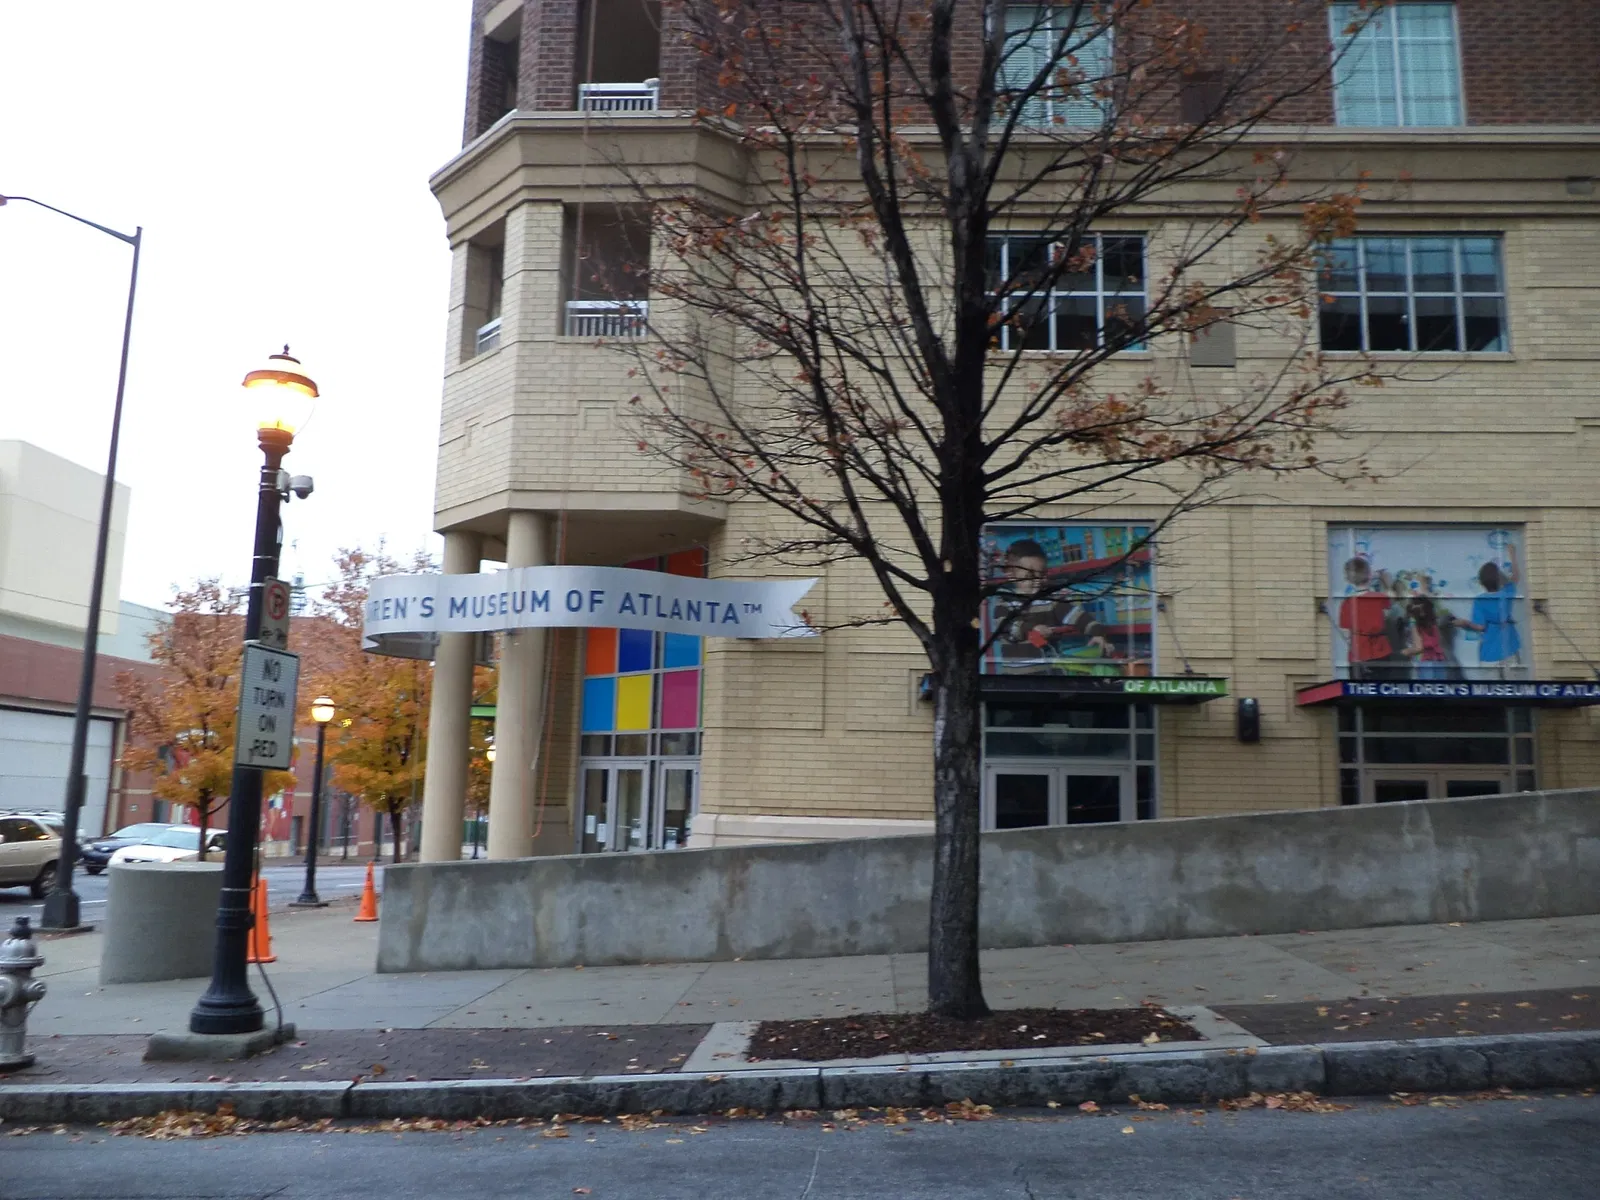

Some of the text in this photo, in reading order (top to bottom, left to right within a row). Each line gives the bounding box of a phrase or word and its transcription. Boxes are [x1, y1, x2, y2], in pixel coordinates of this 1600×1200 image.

[448, 589, 551, 619] MUSEUM
[566, 589, 606, 613] OF
[261, 658, 282, 683] NO
[253, 686, 286, 709] TURN
[1124, 680, 1217, 694] OF ATLANTA
[1347, 683, 1377, 696] THE
[1379, 683, 1469, 696] CHILDREN'S
[1471, 683, 1537, 696] MUSEUM
[1540, 683, 1561, 696] OF
[257, 713, 277, 733] ON
[252, 738, 278, 759] RED
